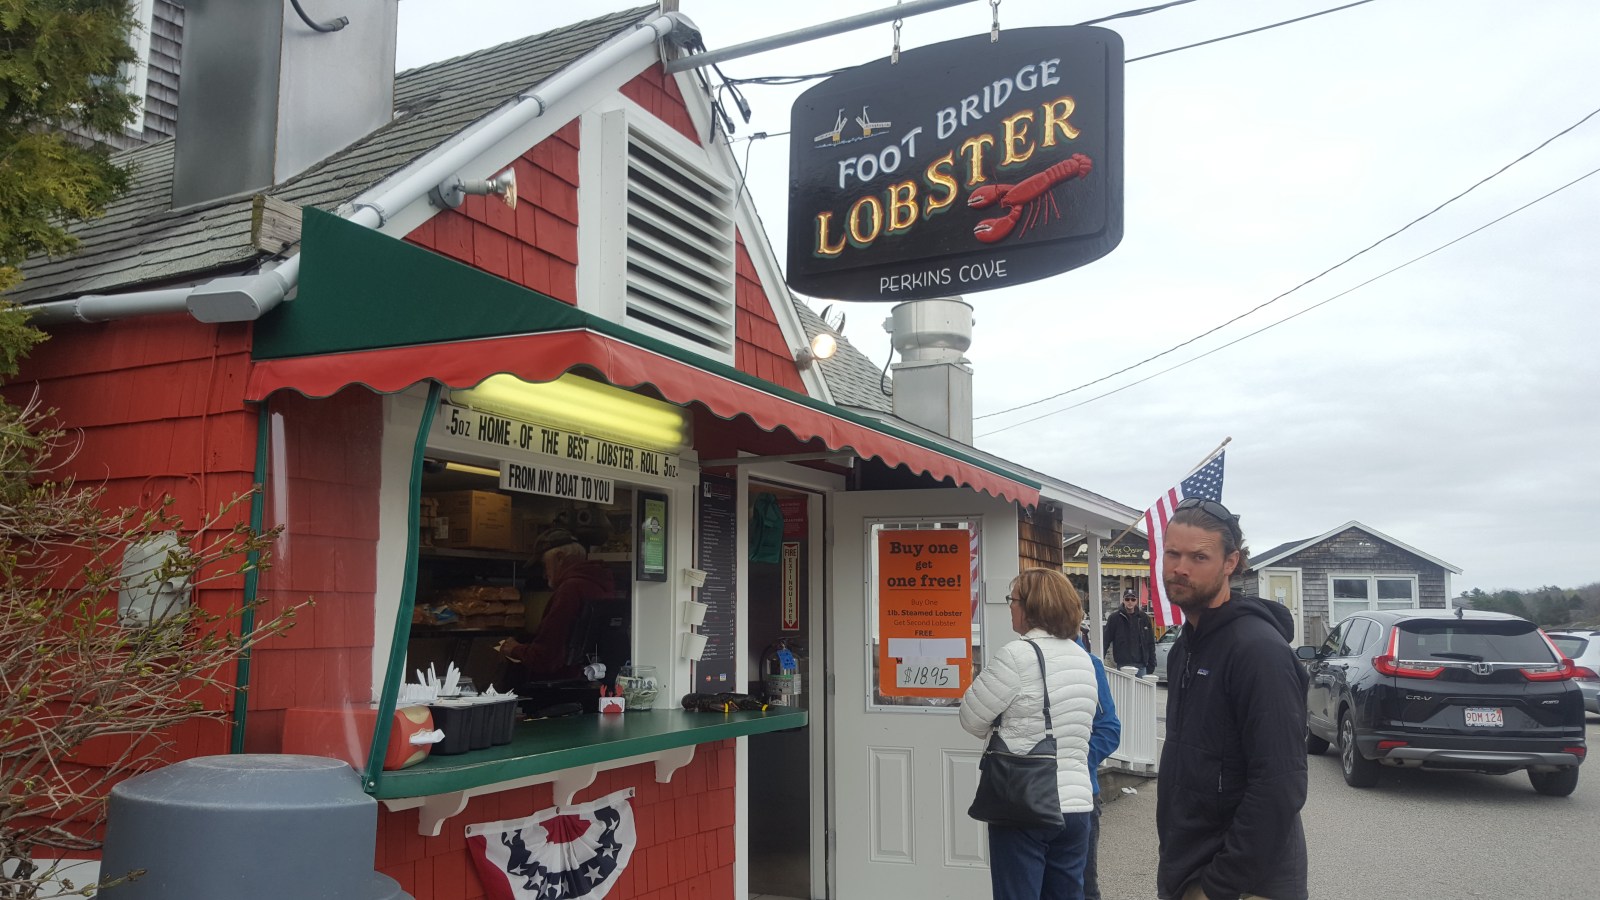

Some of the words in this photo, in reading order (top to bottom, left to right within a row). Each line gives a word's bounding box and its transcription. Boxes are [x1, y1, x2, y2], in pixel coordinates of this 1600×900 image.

[838, 126, 923, 189] FOOT
[936, 57, 1061, 140] BRIDGE
[815, 95, 1081, 257] LOBSTER
[880, 268, 951, 294] PERKINS
[959, 259, 1007, 282] COVE
[478, 415, 511, 446] HOME
[519, 423, 534, 450] OF
[541, 428, 560, 456] THE
[567, 434, 589, 462] BEST
[596, 441, 634, 470] LOBSTER
[640, 451, 658, 475] ROLL
[508, 463, 536, 492] FROM
[537, 469, 554, 494] MY
[555, 472, 579, 498] BOAT
[581, 476, 592, 500] TO
[593, 478, 610, 503] YOU
[784, 548, 797, 557] FIRE
[889, 541, 924, 557] Buy
[929, 543, 959, 554] one
[915, 561, 933, 570] get
[887, 575, 917, 588] one
[920, 574, 962, 588] free!
[901, 609, 933, 617] Steamed
[1466, 712, 1483, 723] 9DM
[1485, 712, 1503, 723] 124
